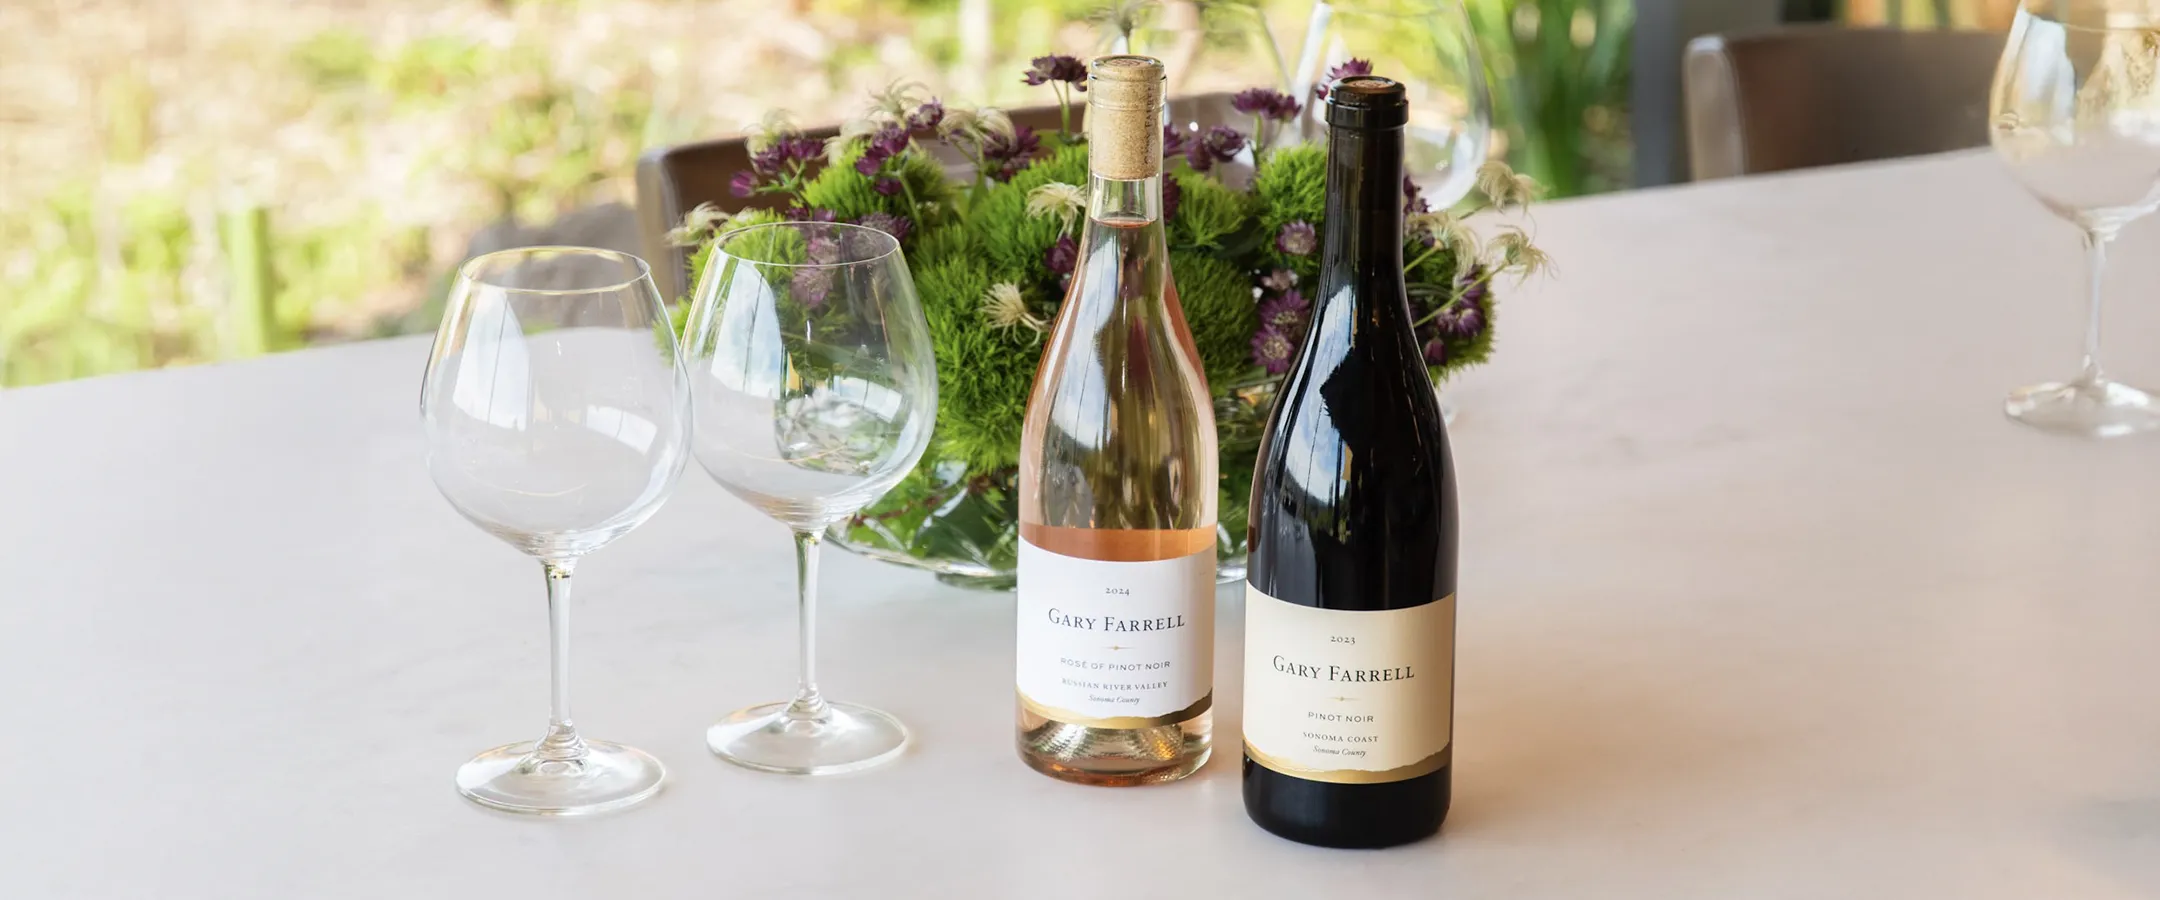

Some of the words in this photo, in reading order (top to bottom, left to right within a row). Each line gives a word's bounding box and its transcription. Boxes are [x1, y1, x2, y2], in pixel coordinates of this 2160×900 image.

[1105, 587, 1130, 596] 2024
[1048, 607, 1097, 631] GARY
[1104, 614, 1186, 632] FARRELL
[1330, 635, 1356, 645] 2023
[1060, 657, 1088, 669] ROSÉ
[1091, 662, 1105, 670] OF
[1108, 663, 1142, 671] PINOT
[1145, 661, 1171, 670] NOIR
[1273, 655, 1322, 679] GARY
[1329, 665, 1415, 683] FARRELL
[1062, 677, 1099, 689] RUSSIAN
[1103, 683, 1132, 691] RIVER
[1134, 681, 1168, 690] VALLEY
[1088, 694, 1114, 703] Sonoma
[1116, 696, 1140, 705] County
[1307, 711, 1342, 722] PINOT
[1345, 715, 1374, 723] NOIR
[1303, 731, 1344, 742] SONOMA
[1347, 735, 1379, 743] COAST
[1313, 745, 1340, 755] Sonoma
[1341, 748, 1366, 758] County
